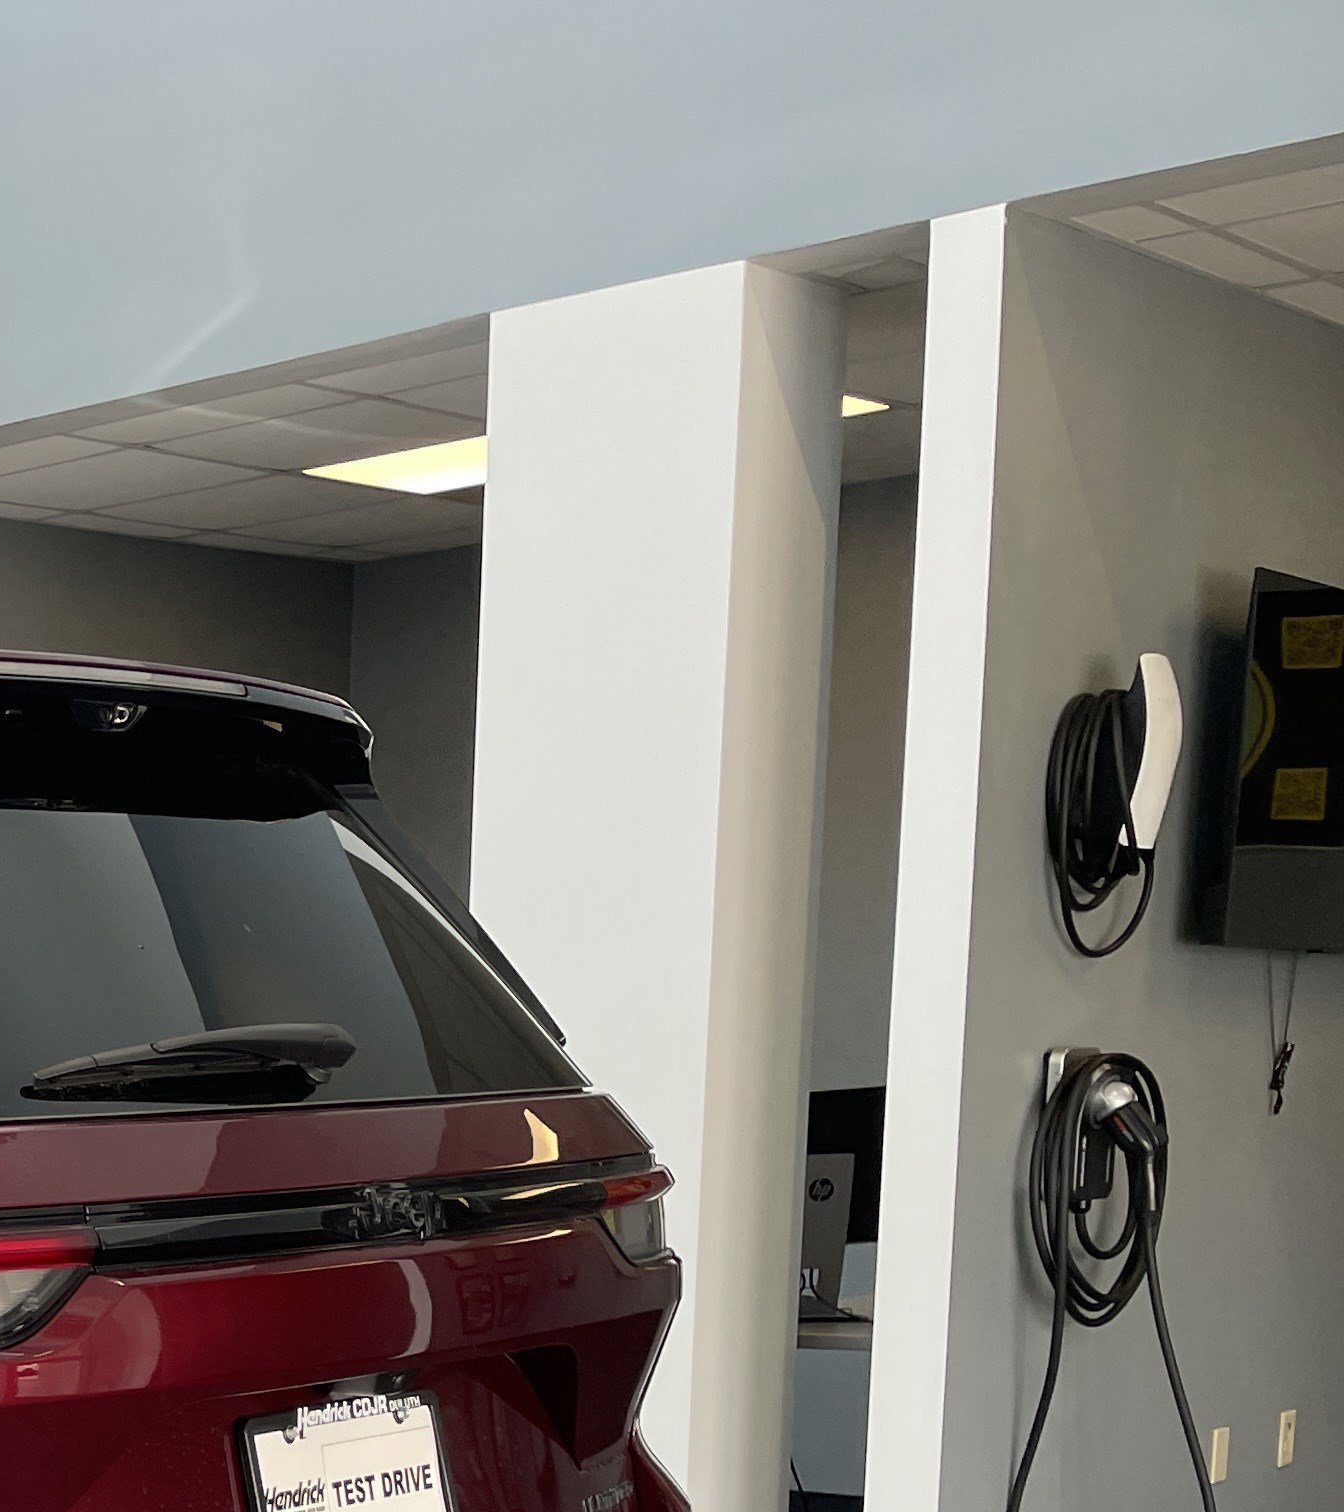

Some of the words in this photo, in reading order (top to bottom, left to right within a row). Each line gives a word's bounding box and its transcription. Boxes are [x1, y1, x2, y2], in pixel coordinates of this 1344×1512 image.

[809, 1178, 834, 1201] hp
[297, 1401, 351, 1439] Hendrick
[353, 1395, 387, 1418] CDJR
[332, 1475, 375, 1507] TEST
[381, 1464, 432, 1498] DRIVE
